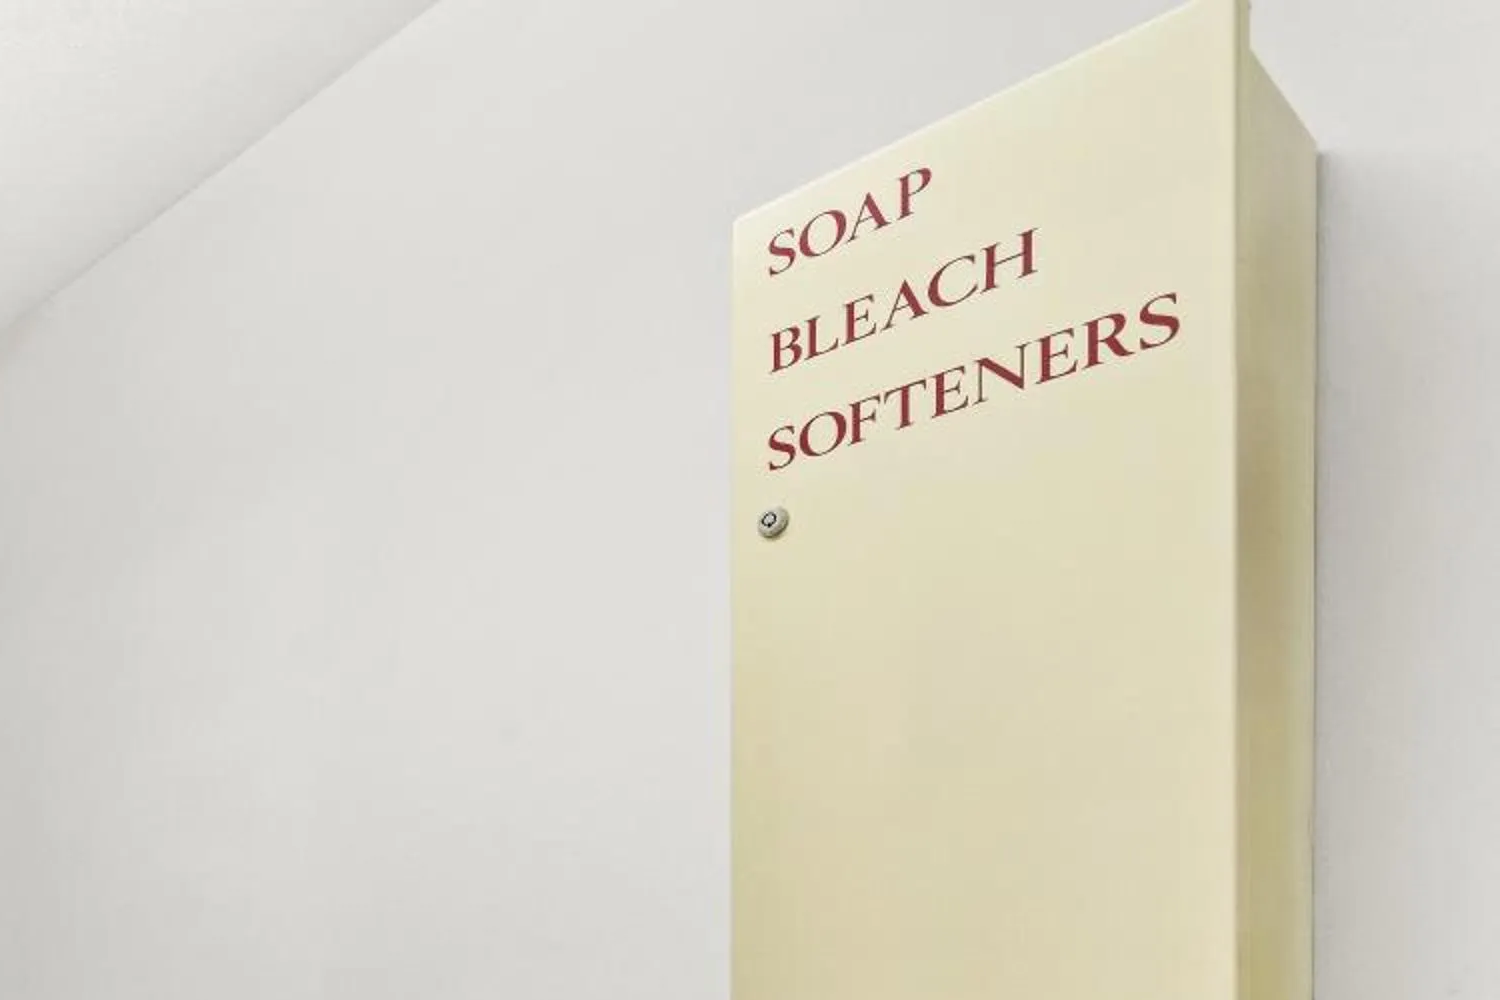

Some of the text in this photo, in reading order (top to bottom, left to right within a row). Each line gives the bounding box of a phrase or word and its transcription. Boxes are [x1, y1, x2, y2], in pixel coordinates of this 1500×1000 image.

[767, 167, 932, 276] SOAP
[768, 227, 1039, 374] BLEACH
[767, 292, 1181, 471] SOFTENERS
